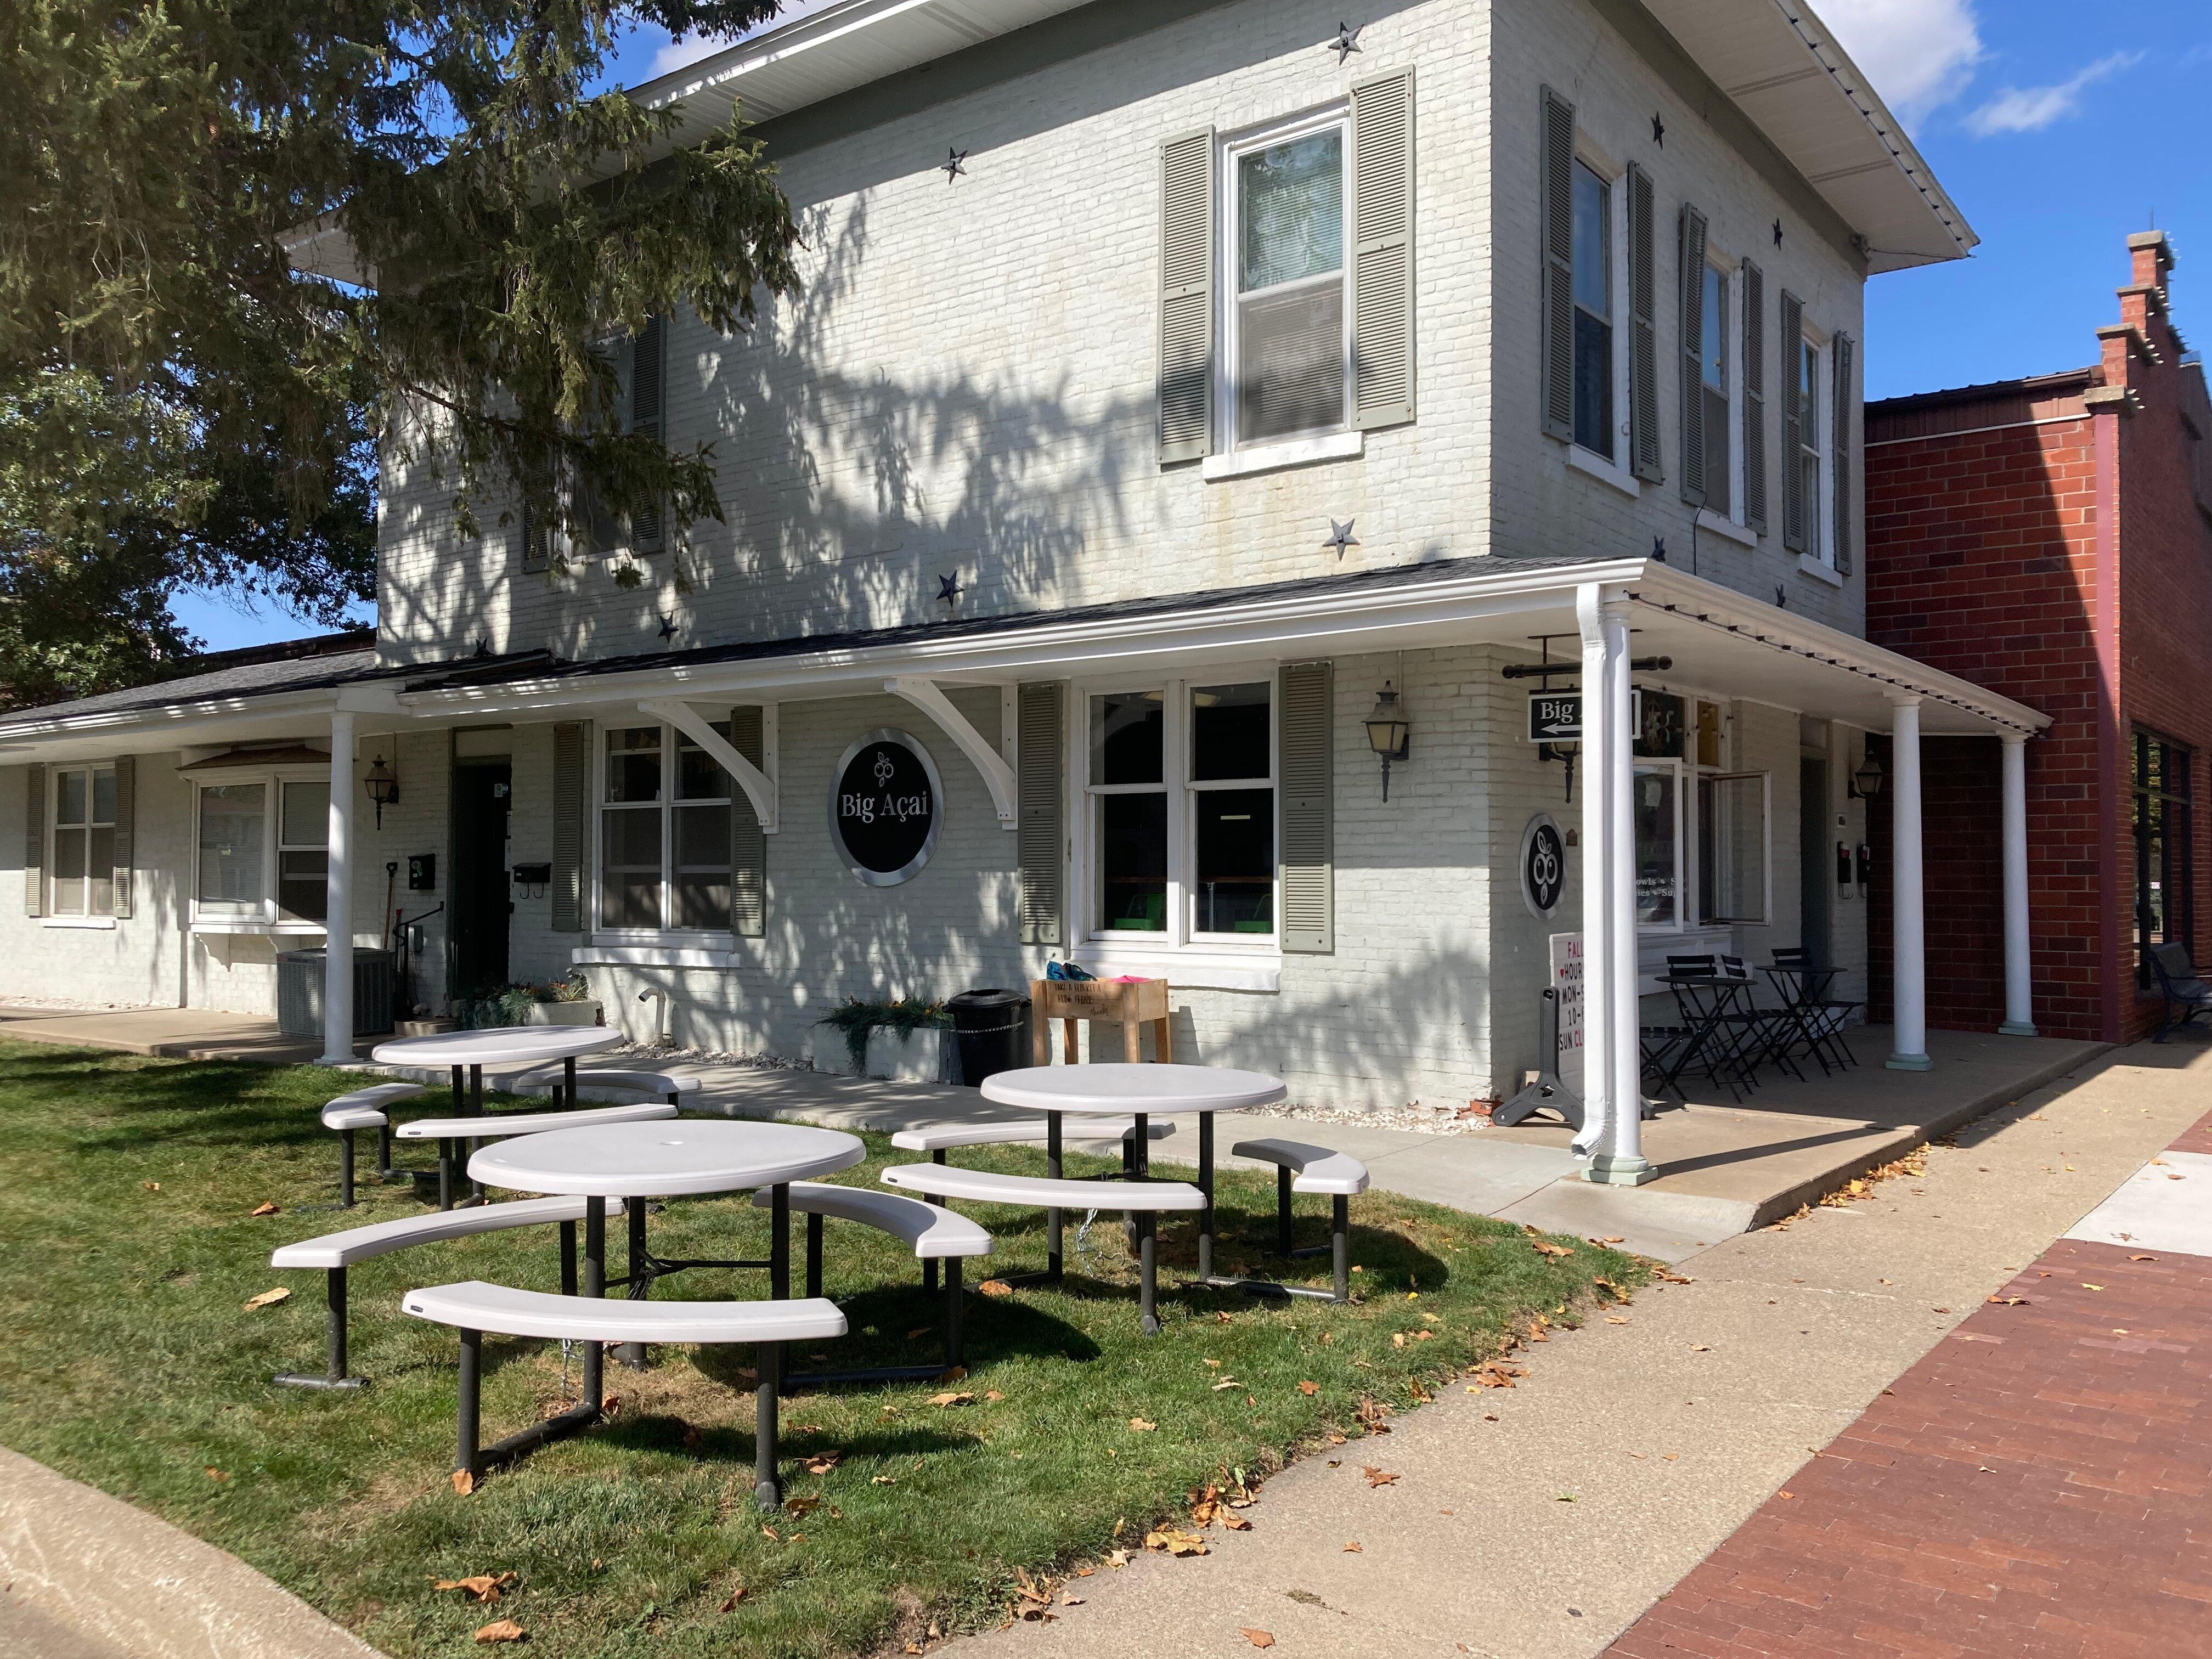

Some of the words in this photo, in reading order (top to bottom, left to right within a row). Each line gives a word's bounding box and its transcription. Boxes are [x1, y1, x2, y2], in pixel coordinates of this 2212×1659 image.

[1540, 701, 1574, 724] Big
[841, 793, 875, 823] Big
[880, 791, 928, 822] Açai
[1559, 1031, 1573, 1051] SUN
